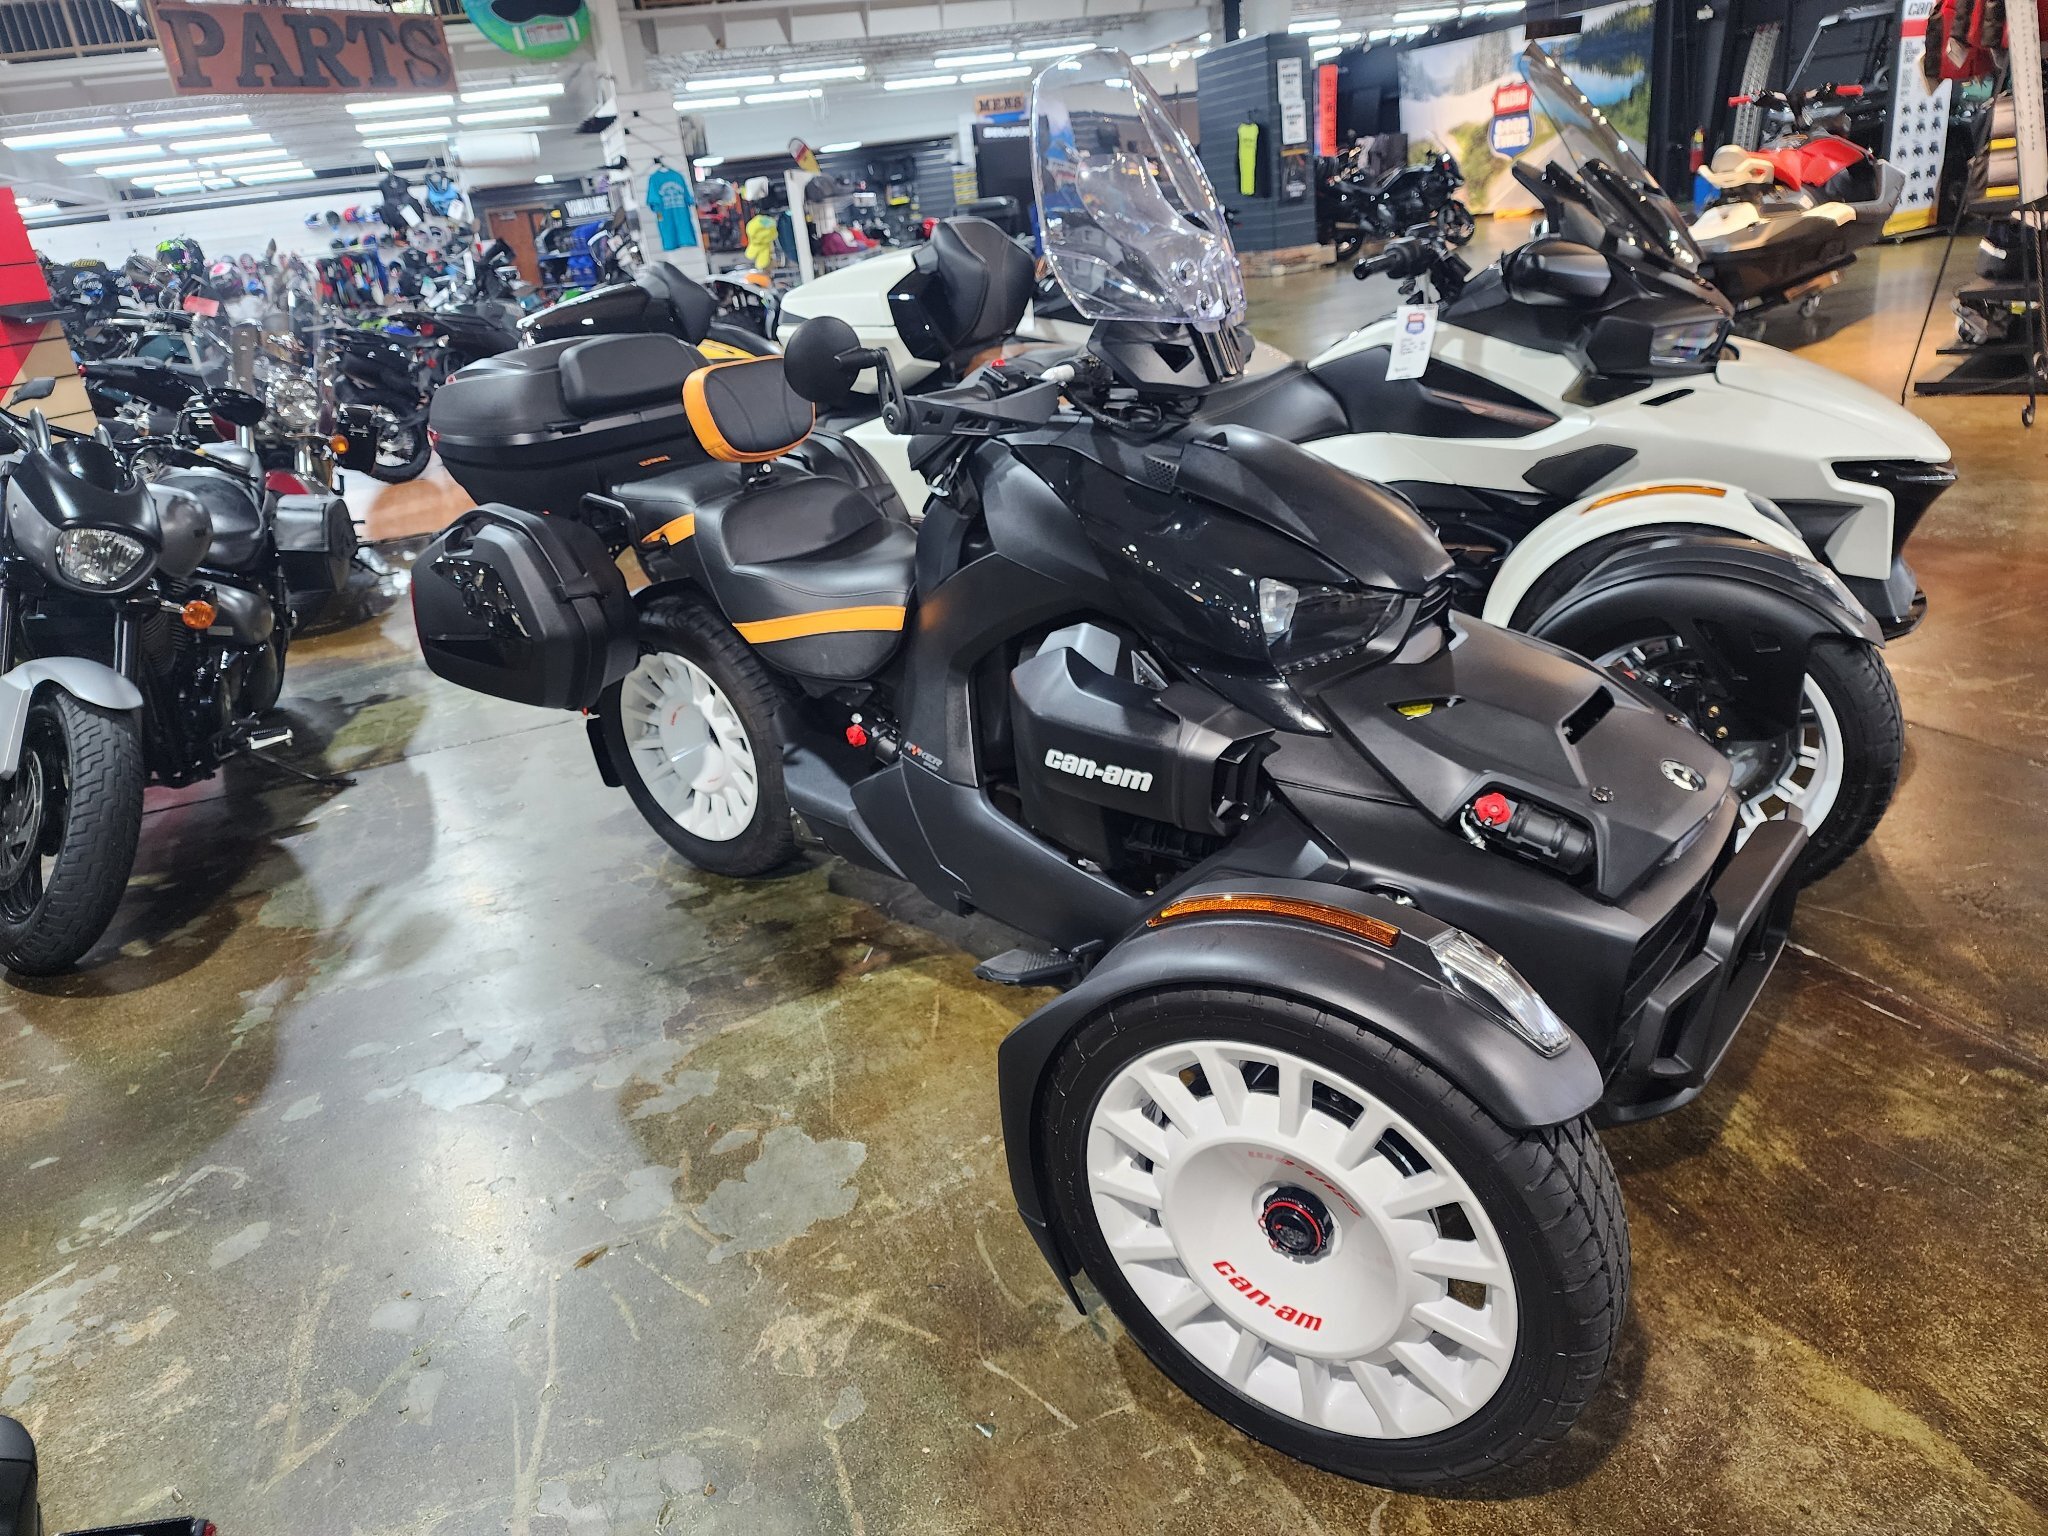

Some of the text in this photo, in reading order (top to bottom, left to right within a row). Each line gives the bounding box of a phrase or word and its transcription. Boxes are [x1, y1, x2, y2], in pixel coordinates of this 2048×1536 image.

[159, 9, 453, 88] PARTS
[1044, 748, 1154, 793] can-am
[1213, 1260, 1323, 1332] can-am
